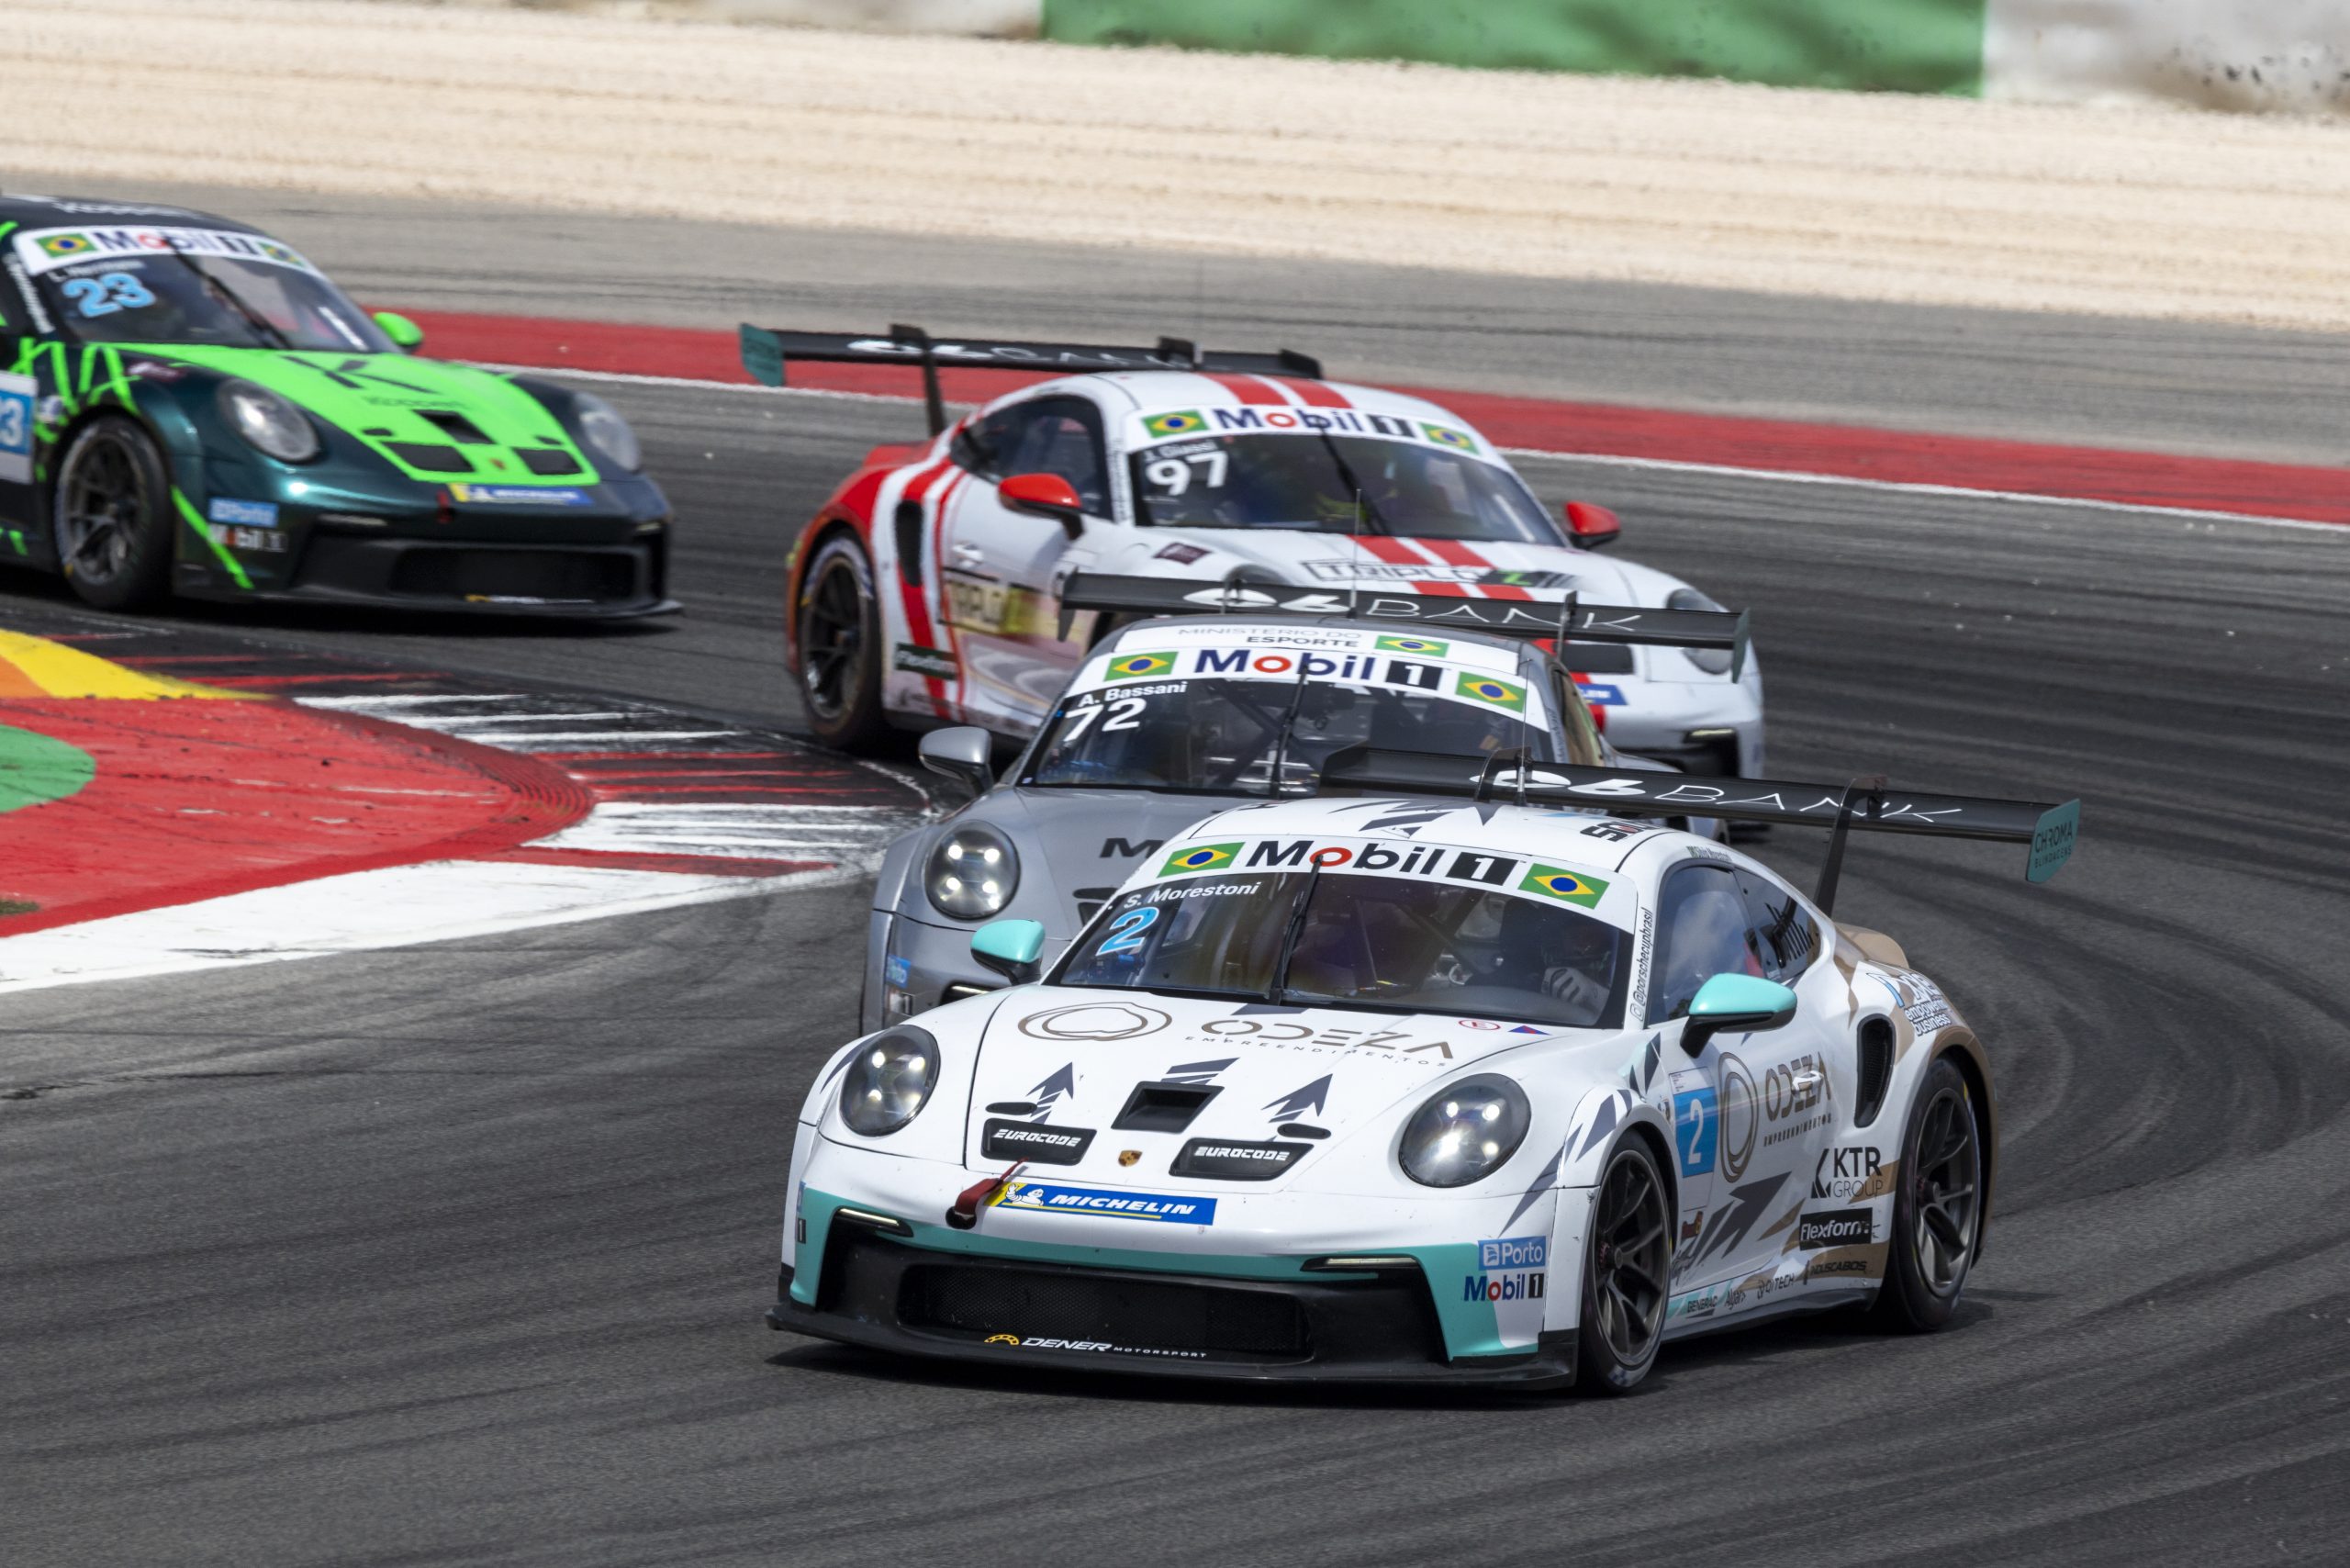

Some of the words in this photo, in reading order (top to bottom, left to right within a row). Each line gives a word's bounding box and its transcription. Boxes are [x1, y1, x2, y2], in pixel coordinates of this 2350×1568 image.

[62, 273, 156, 318] 23
[1212, 408, 1365, 432] Mobil
[1145, 450, 1229, 496] 97
[1366, 599, 1643, 633] BANK
[1246, 635, 1360, 648] ESPORTE
[1326, 632, 1362, 640] DO
[1193, 649, 1376, 680] Mobil
[1078, 692, 1100, 708] A.
[1104, 681, 1188, 703] Bassani
[1063, 698, 1147, 743] 72
[1654, 785, 1963, 823] BANK
[2035, 821, 2072, 853] CHROMA
[1245, 839, 1446, 876] Mobil
[1123, 893, 1142, 909] S.
[1147, 881, 1261, 904] Morestoni
[1096, 906, 1159, 957] 2
[1201, 1019, 1454, 1059] ODEZA
[1914, 1012, 1952, 1036] business
[1184, 1036, 1447, 1068] EMPREENDIMENTOS
[992, 1128, 1082, 1148] EUROCODE
[1687, 1098, 1705, 1165] 2
[1193, 1146, 1292, 1161] EUROCODE
[1833, 1146, 1883, 1178] KTR
[1049, 1193, 1197, 1215] MICHELIN
[1833, 1180, 1884, 1199] GROUP
[1502, 1243, 1544, 1265] Porto
[1464, 1273, 1526, 1302] Mobil
[1022, 1337, 1113, 1352] DENER
[1113, 1346, 1207, 1359] MOTORSPORT
